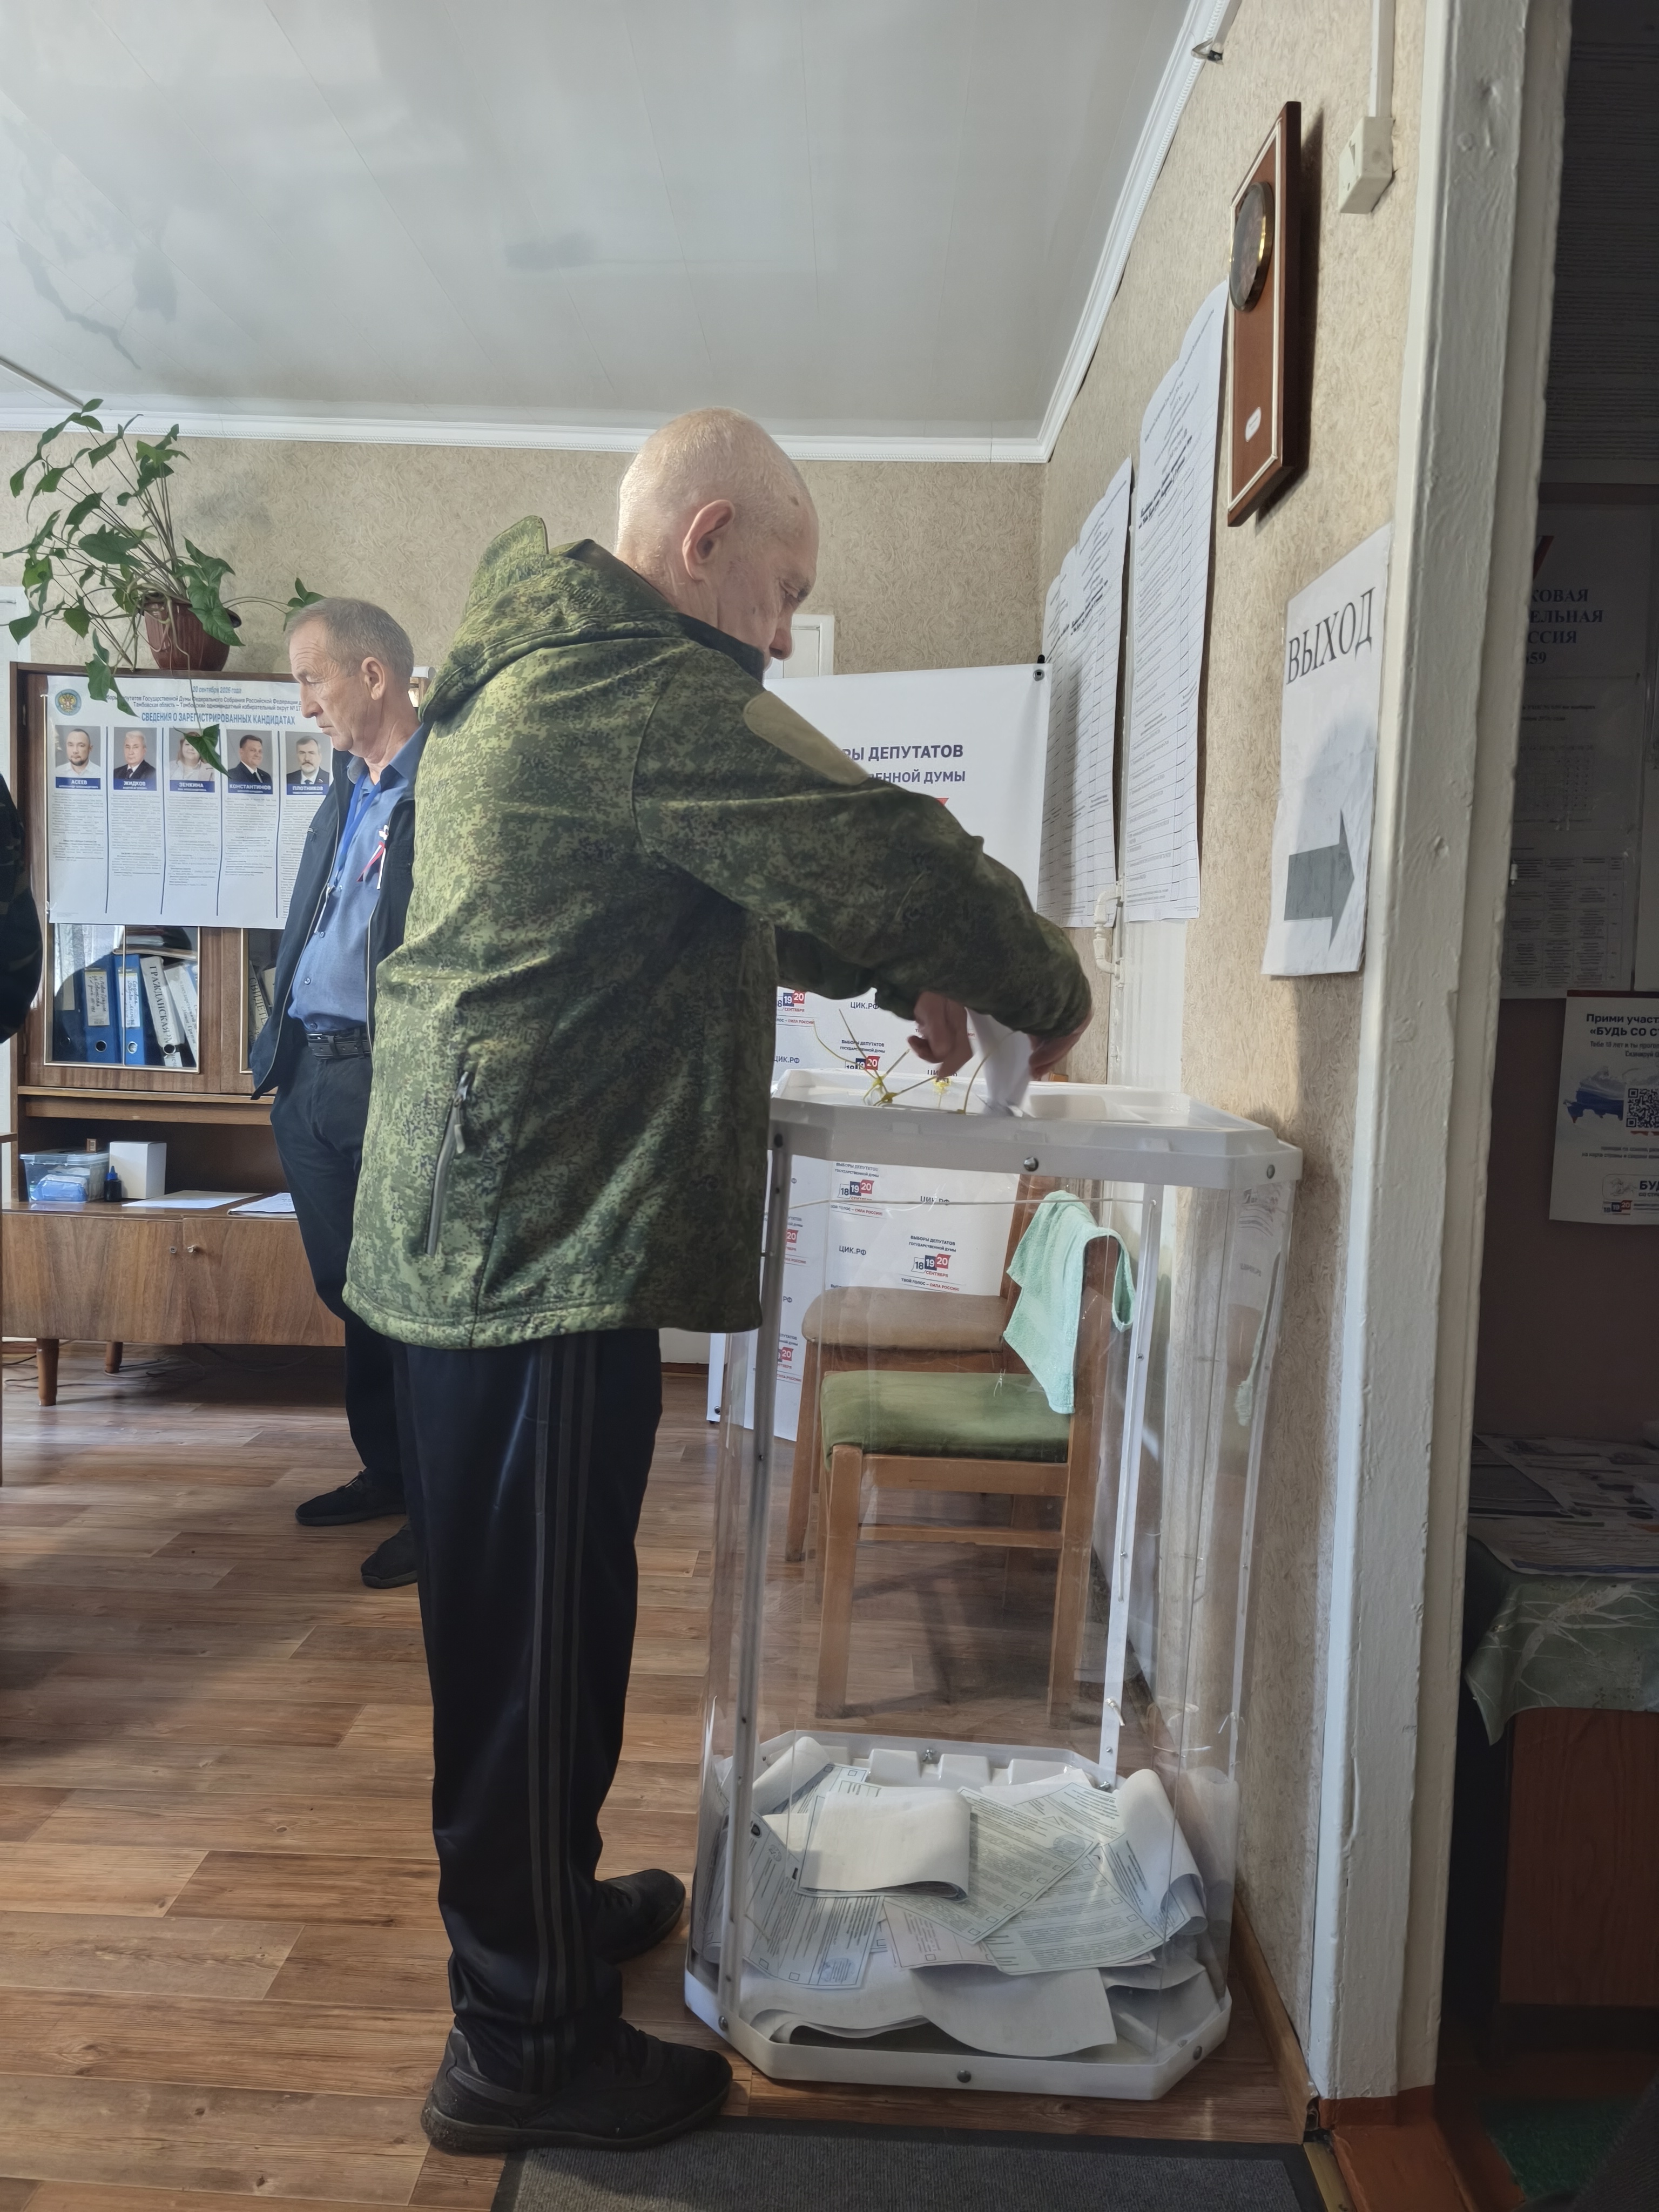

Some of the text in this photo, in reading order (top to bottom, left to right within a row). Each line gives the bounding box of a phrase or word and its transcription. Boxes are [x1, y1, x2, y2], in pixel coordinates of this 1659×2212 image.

[1286, 587, 1376, 686] ВЫХОД
[141, 712, 295, 726] СВЕДЕНИЯ О ЗАРЕГИСТРИРОВАННЫХ КАНДИДАТАХ
[868, 744, 963, 761] ДЕПУТАТОВ
[923, 771, 966, 784] ДУМЫ
[150, 966, 168, 1033] ГРАЖДАНСКАЯ
[784, 995, 792, 1004] 19
[793, 993, 804, 1001] 20
[851, 1002, 879, 1010] ЦИК.РФ
[1586, 1014, 1659, 1026] Прими участ
[1590, 1027, 1627, 1037] «БУДЬ
[1630, 1028, 1647, 1036] СО
[867, 1058, 878, 1067] 20
[841, 1183, 872, 1196] 18 19 20
[787, 1232, 797, 1240] 20
[839, 1245, 867, 1256] ЦИК.РФ
[909, 1242, 945, 1251] ГОСУДАРСТВЕННОЙ
[915, 1257, 948, 1270] 18 19 20
[781, 1349, 792, 1358] 20
